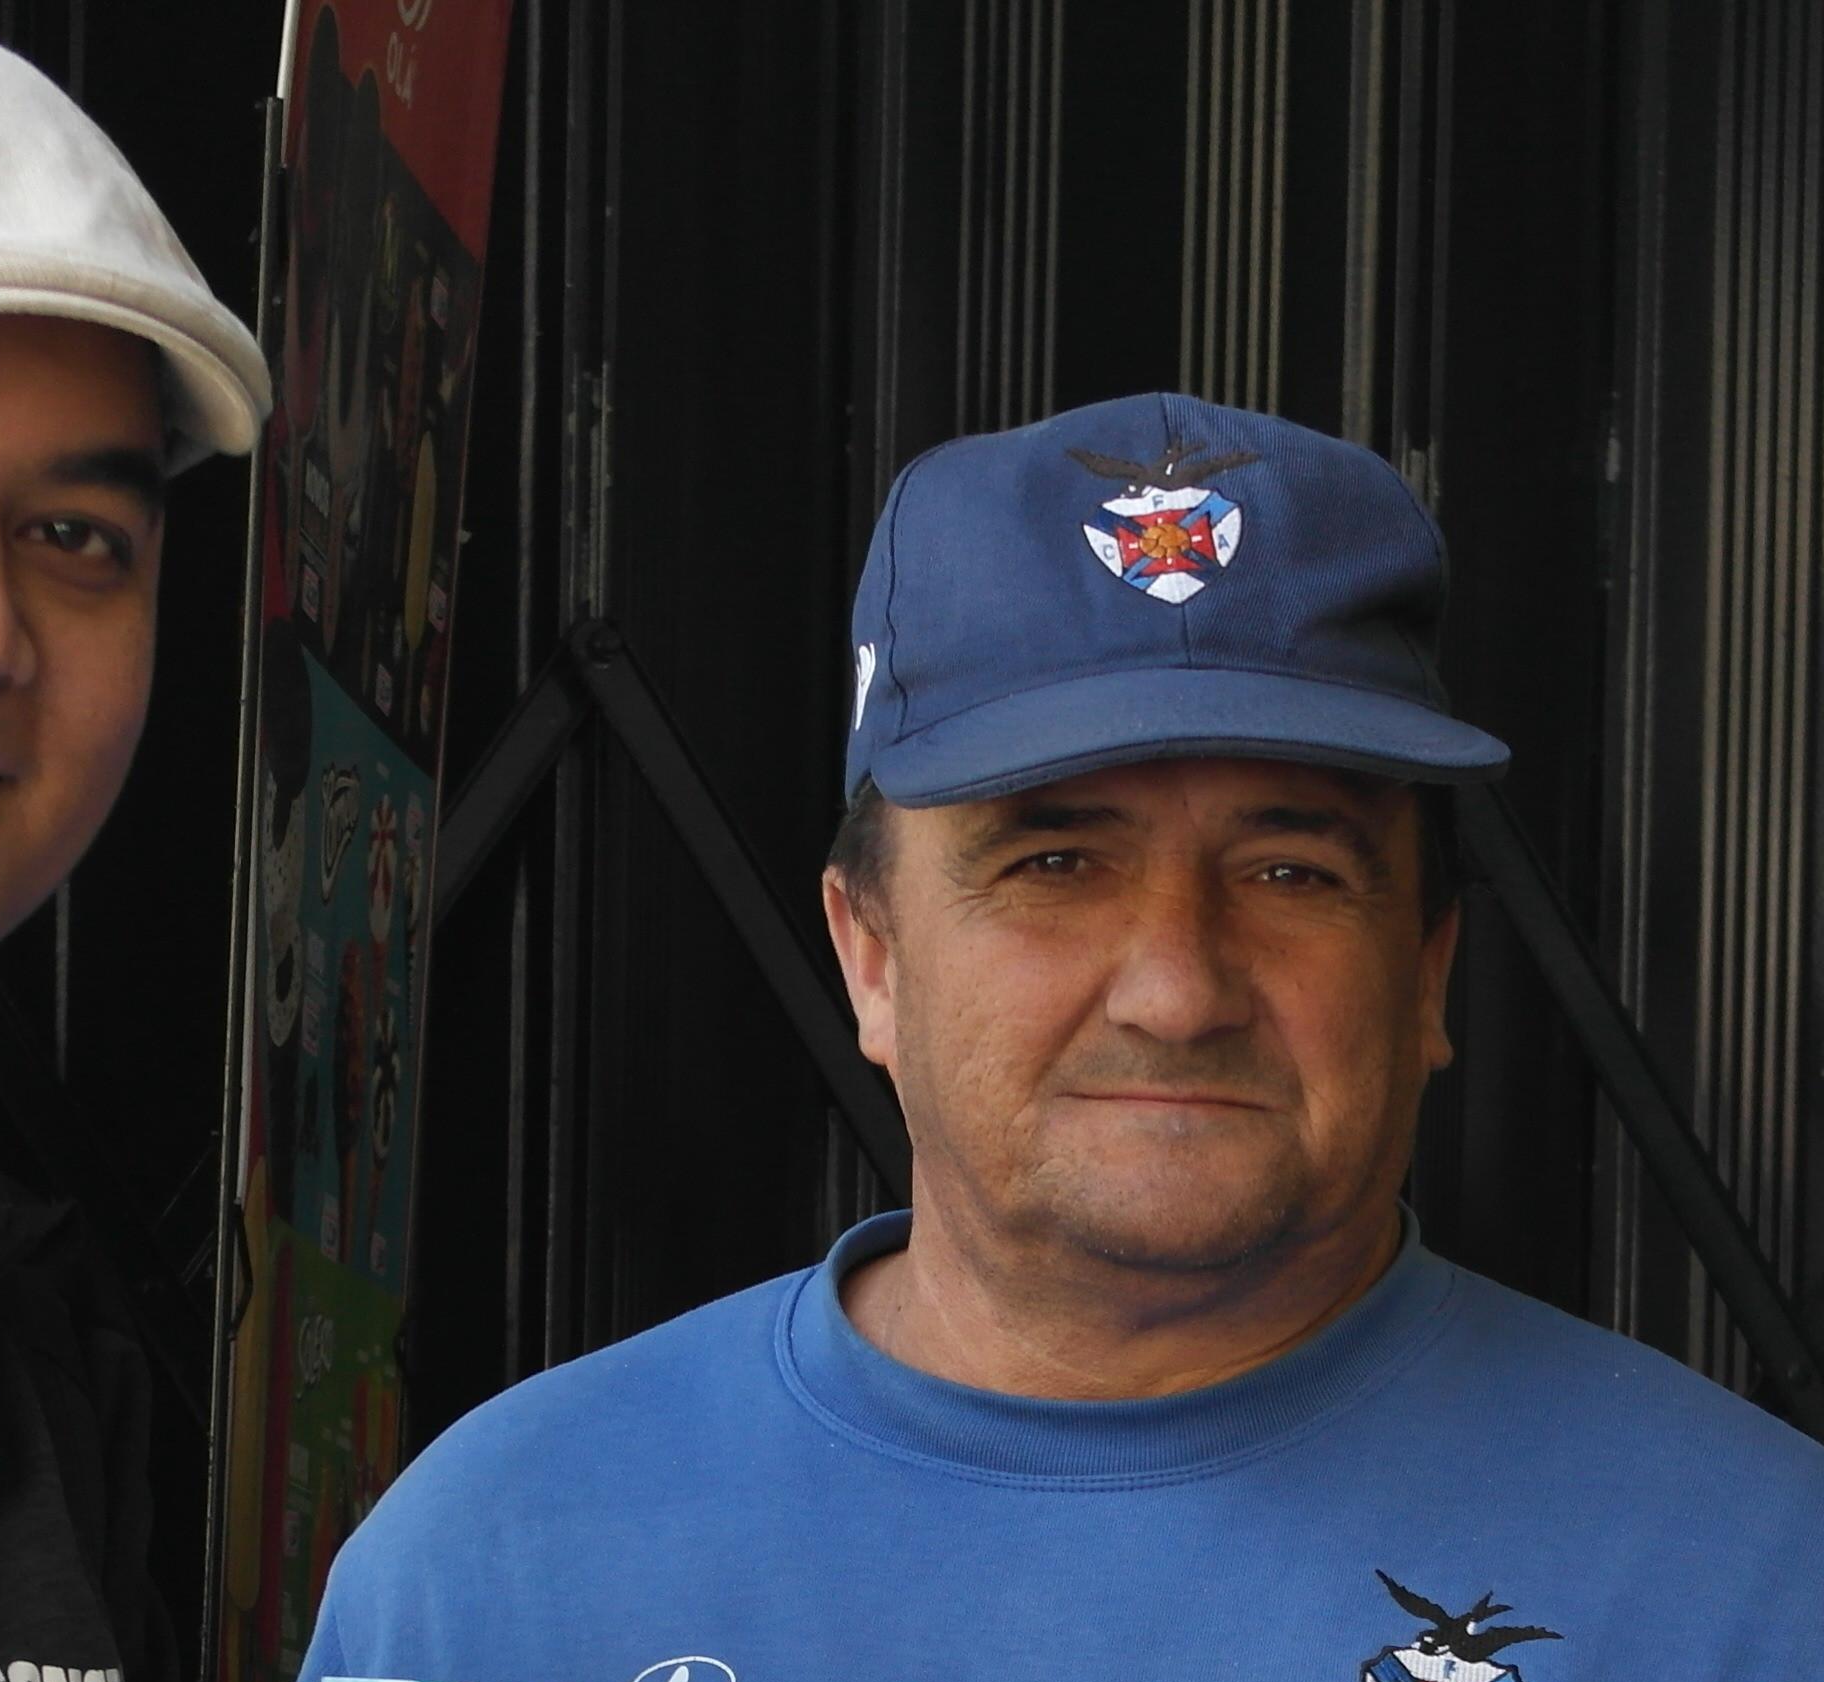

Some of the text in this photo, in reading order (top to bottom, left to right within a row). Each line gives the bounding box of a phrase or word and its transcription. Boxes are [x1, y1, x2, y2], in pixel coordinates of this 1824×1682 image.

[1151, 494, 1165, 508] F
[1218, 533, 1231, 550] A
[1102, 543, 1114, 561] C
[1442, 1659, 1457, 1679] F
